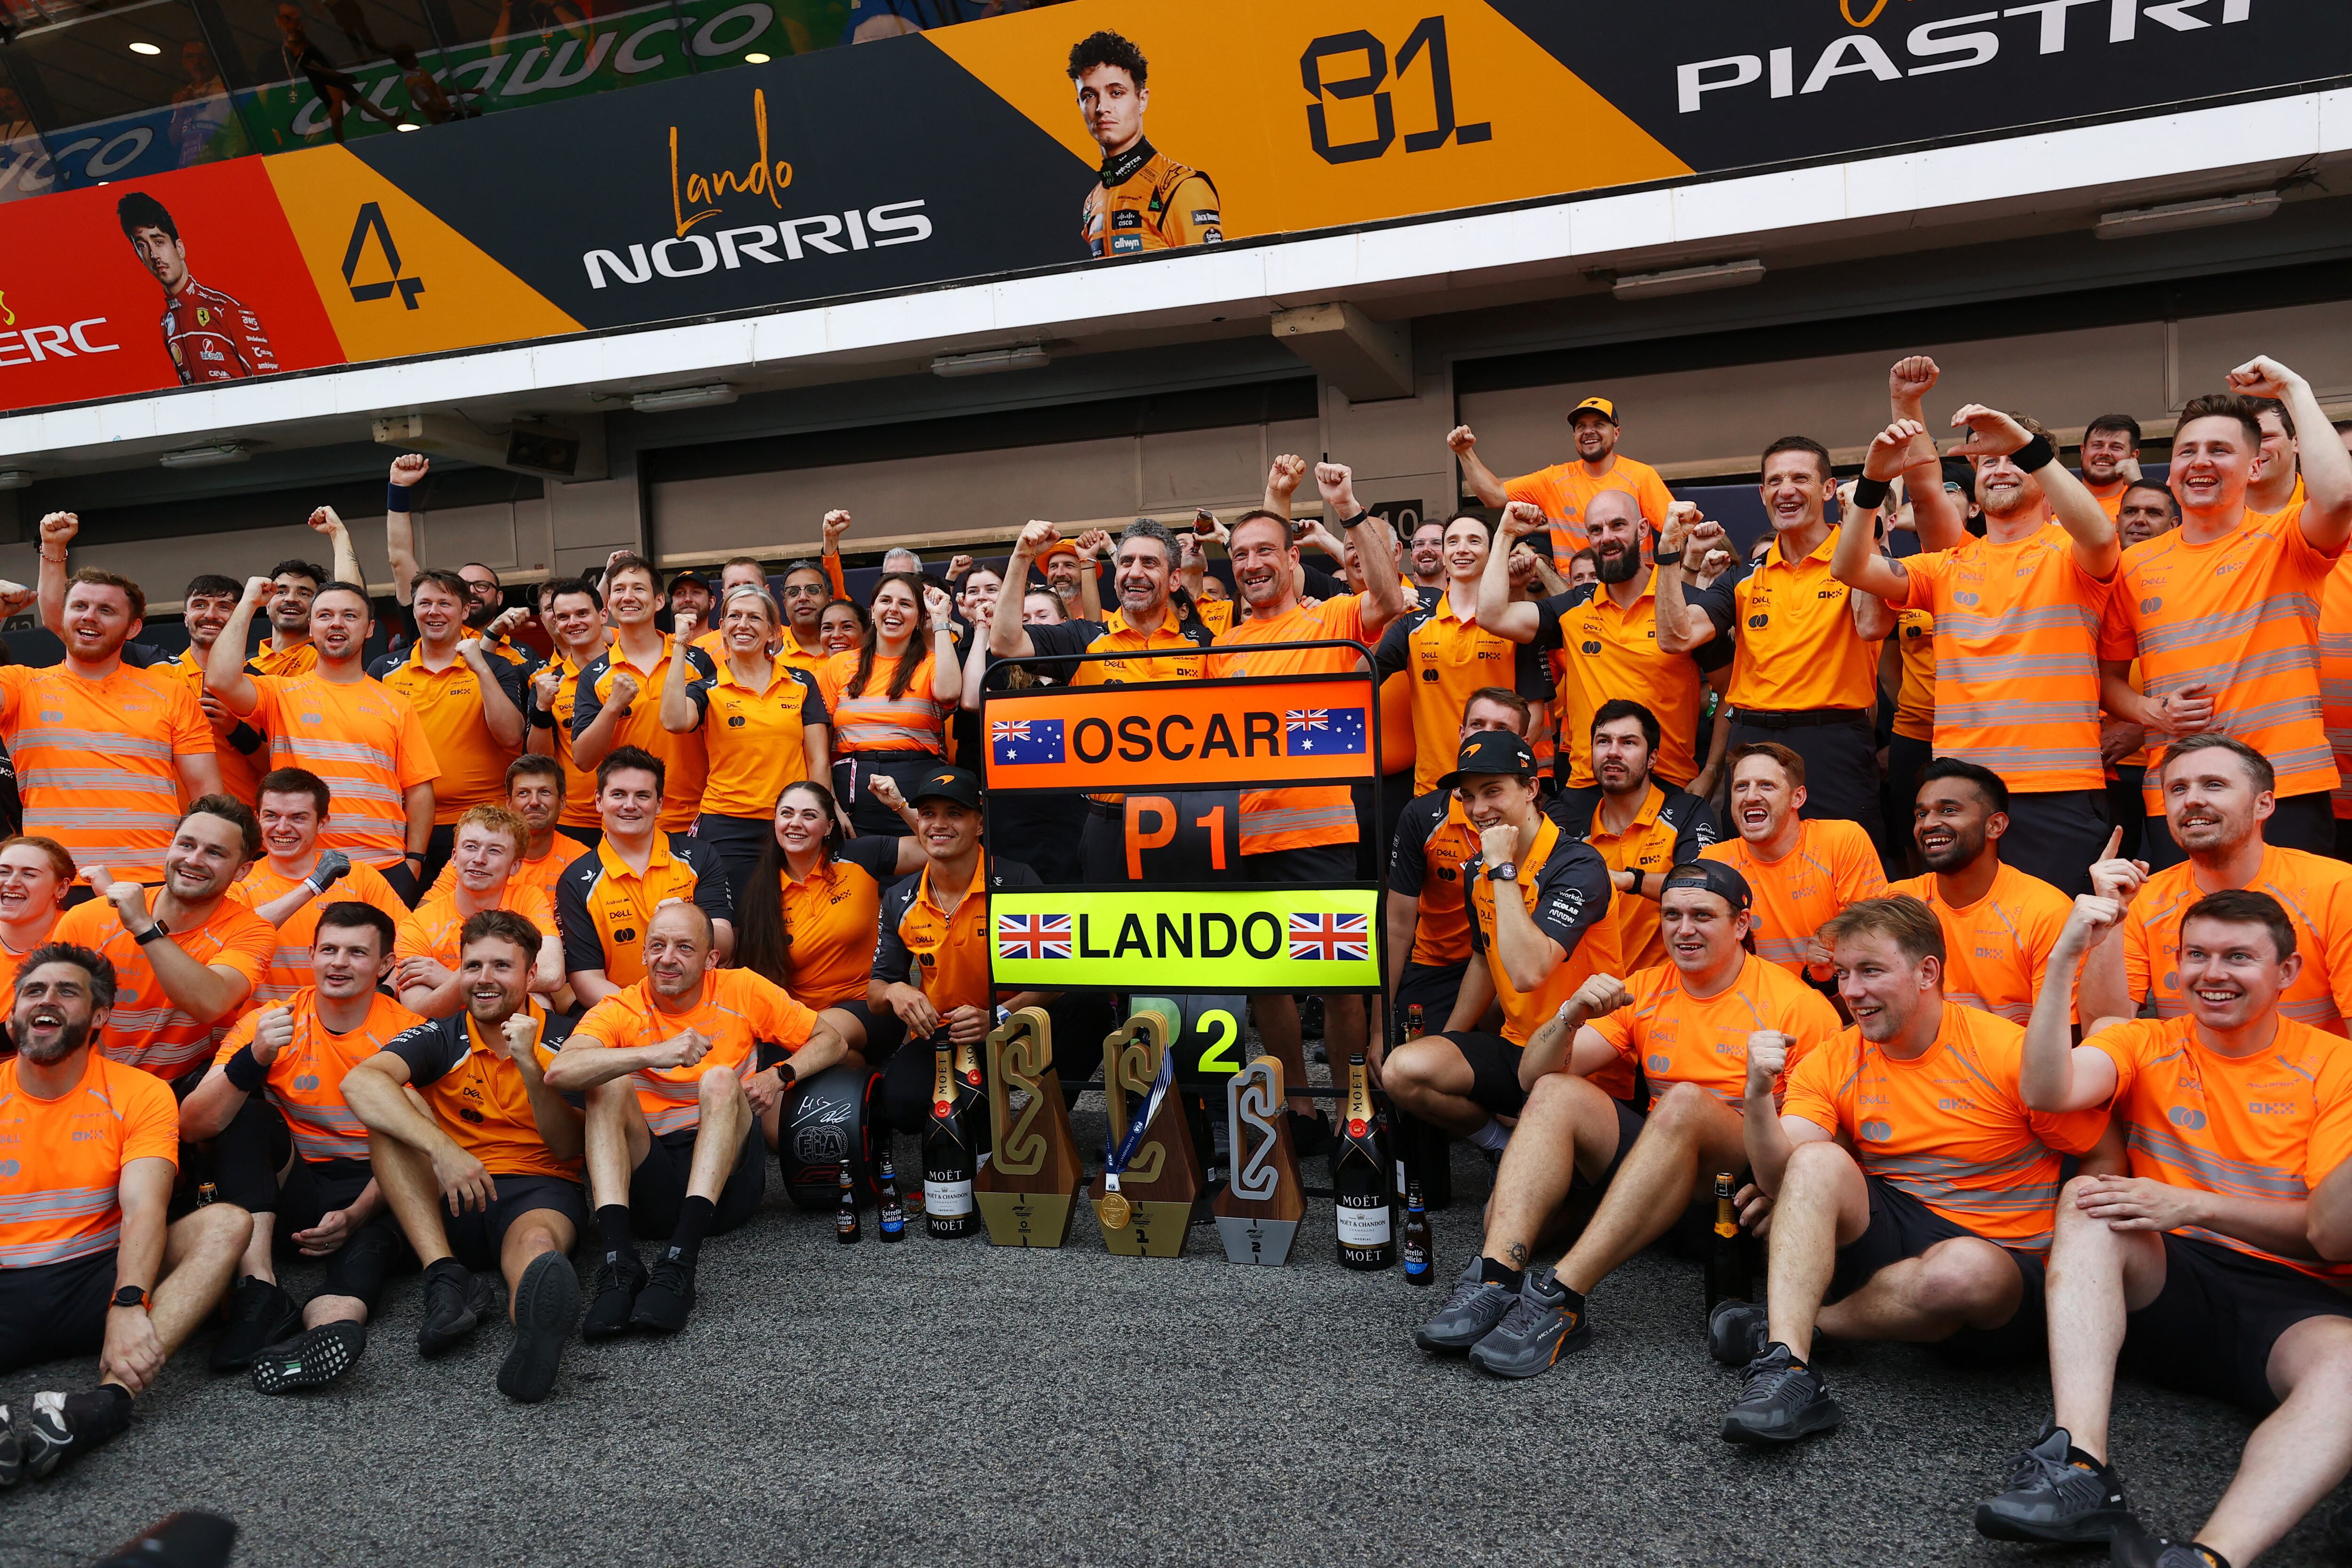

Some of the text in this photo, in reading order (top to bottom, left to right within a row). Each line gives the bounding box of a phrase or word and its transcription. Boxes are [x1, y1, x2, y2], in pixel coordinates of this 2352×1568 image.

[1300, 15, 1492, 165] 81
[668, 88, 793, 238] Lando
[1115, 155, 1142, 176] MONSTER
[583, 199, 933, 289] NORRIS
[1114, 236, 1139, 249] allwyn
[341, 201, 425, 310] 4
[242, 316, 258, 326] aws
[200, 352, 224, 361] UniCredit
[1958, 572, 1985, 581] DELL
[2017, 566, 2035, 578] OK
[2141, 577, 2167, 587] DELL
[1818, 588, 1843, 599] OKX
[1752, 596, 1771, 605] DELL
[1104, 660, 1127, 669] DELL
[1176, 668, 1199, 677] OKX
[41, 693, 65, 702] DELL
[1073, 712, 1280, 764] OSCAR
[1437, 849, 1458, 858] DELL
[1529, 860, 1537, 872] CISCO
[1640, 855, 1661, 865] OKX
[667, 881, 691, 893] McLaren
[1863, 876, 1883, 886] ECOLAB
[830, 890, 851, 905] OKX
[1559, 891, 1585, 903] workday
[1792, 885, 1817, 900] OKX
[1552, 900, 1579, 915] ECOLAB
[610, 909, 632, 919] DELL
[1547, 915, 1562, 924] RICHARD
[1549, 909, 1575, 924] ARROW
[1079, 911, 1282, 960] LANDO
[1976, 947, 2004, 959] OKX
[1649, 1030, 1676, 1043] DELL
[1716, 1043, 1745, 1057] OKX
[938, 1058, 947, 1095] MOËT
[1353, 1071, 1363, 1113] MOËT
[1859, 1094, 1890, 1105] DELL
[1939, 1098, 1976, 1110] OKX
[2249, 1102, 2295, 1114] OKX
[1134, 1122, 1144, 1133] FIA
[72, 1129, 104, 1142] OKX
[929, 1170, 962, 1181] MOËT
[1343, 1195, 1379, 1207] MOËT
[931, 1219, 964, 1231] MOËT
[1251, 1242, 1261, 1252] 2
[1345, 1249, 1382, 1261] MOËT
[1536, 1322, 1563, 1342] McLaren
